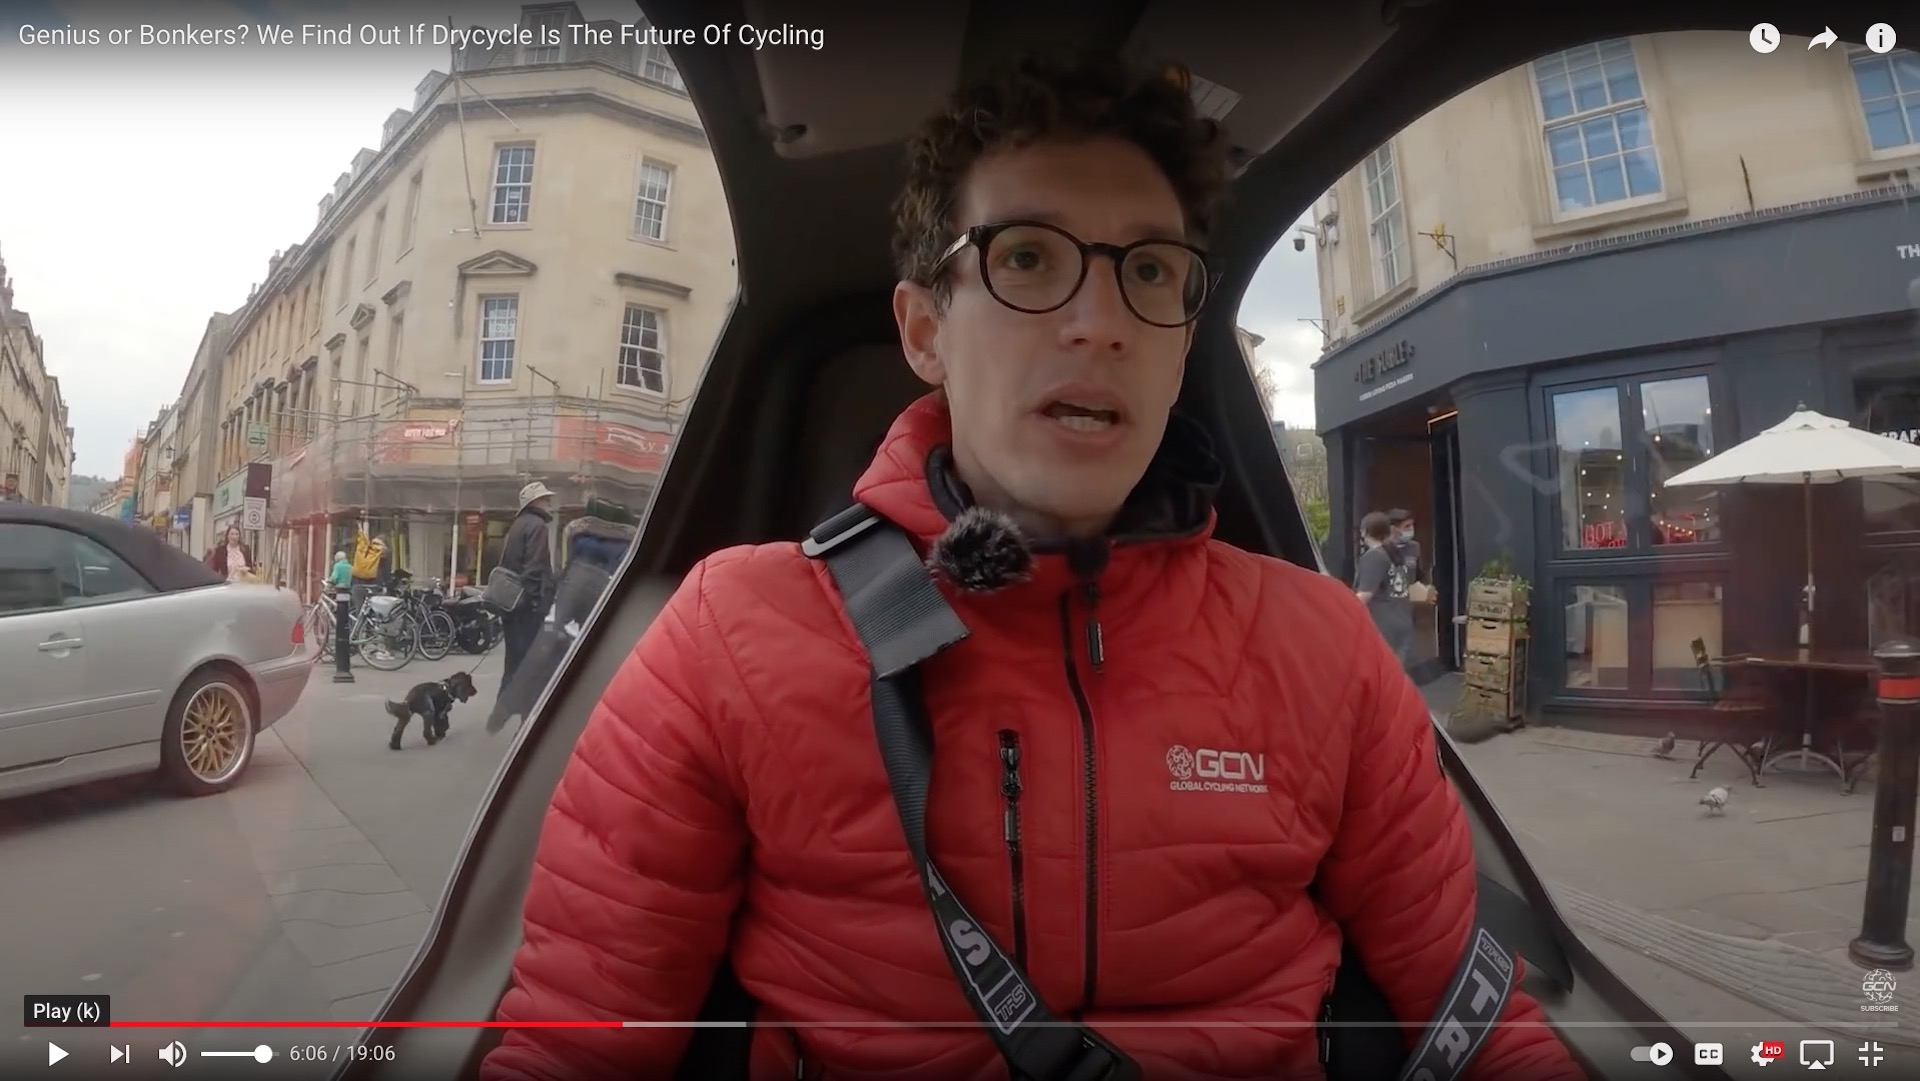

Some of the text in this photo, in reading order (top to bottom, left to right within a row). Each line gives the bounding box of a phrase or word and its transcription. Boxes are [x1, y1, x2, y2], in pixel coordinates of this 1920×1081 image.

[1195, 747, 1265, 781] GCN
[1169, 780, 1269, 794] GLOBAL CYCLING NETWORK
